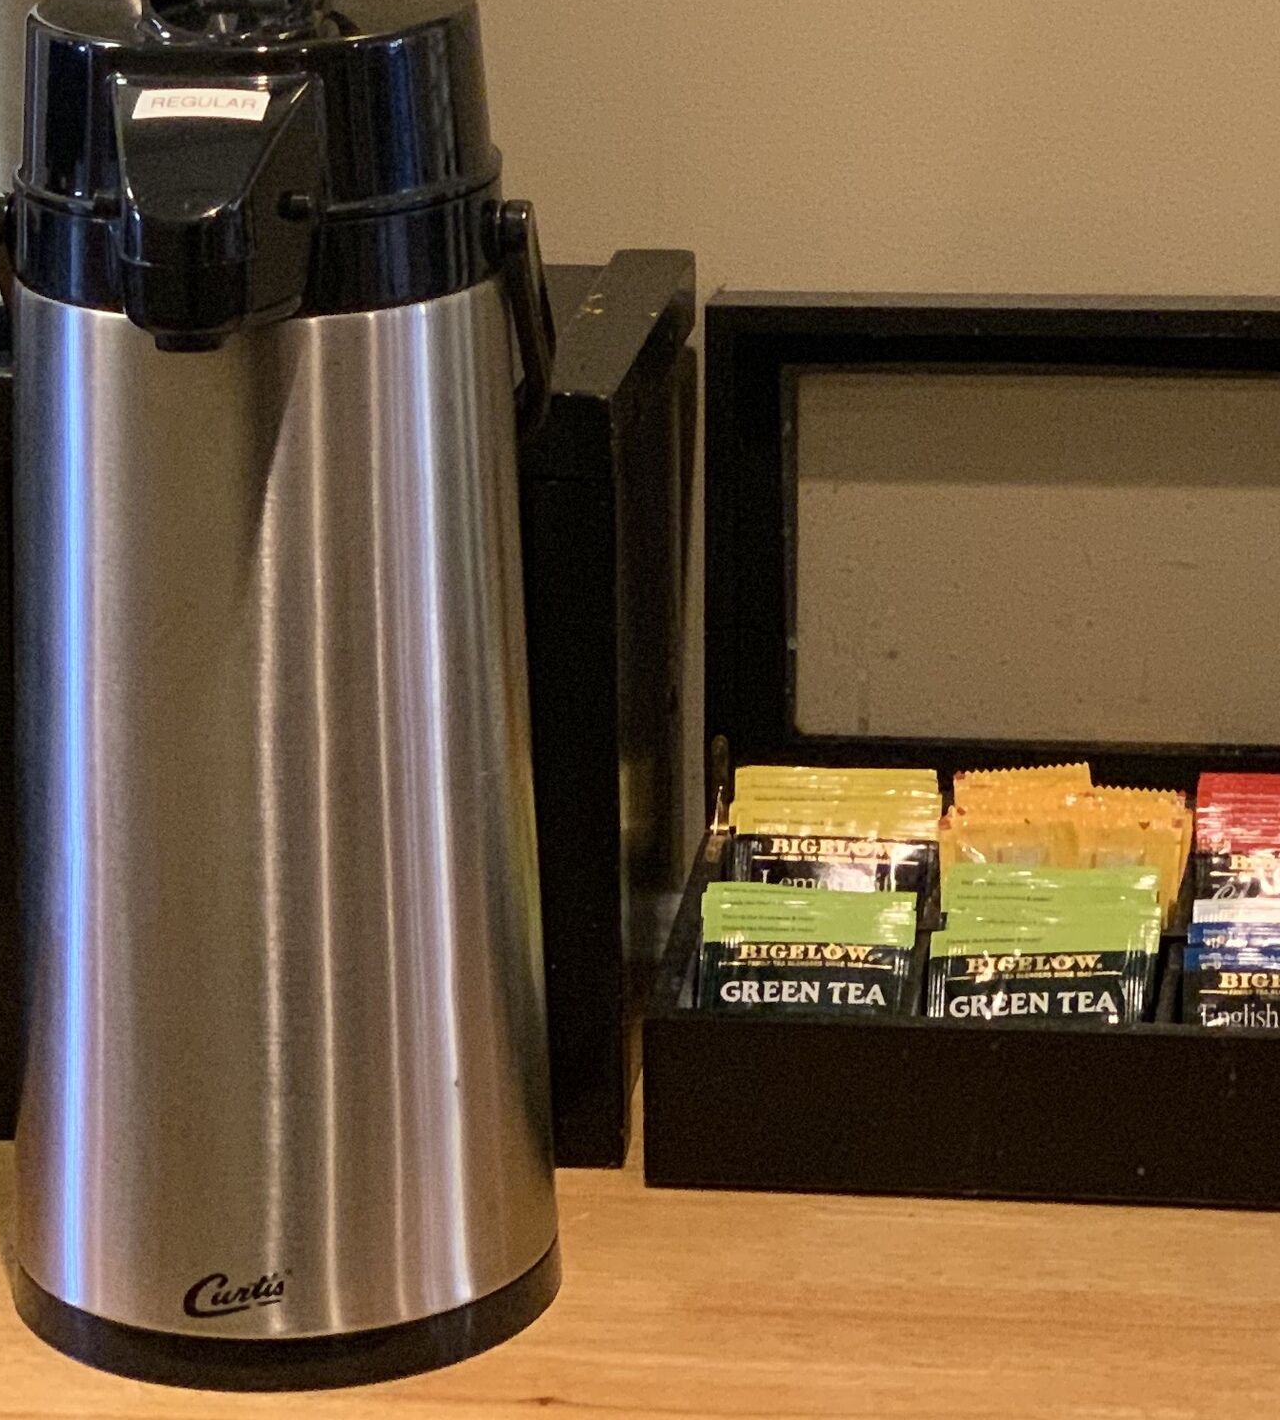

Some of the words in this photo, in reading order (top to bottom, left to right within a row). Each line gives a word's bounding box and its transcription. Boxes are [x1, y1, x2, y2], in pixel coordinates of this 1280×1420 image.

[150, 95, 257, 109] REGULAR
[719, 979, 820, 1004] GREEN
[826, 980, 887, 1006] TEA
[949, 991, 1050, 1018] GREEN
[1056, 990, 1118, 1014] TEA
[1199, 1002, 1279, 1030] English
[182, 1272, 285, 1318] Curtis
